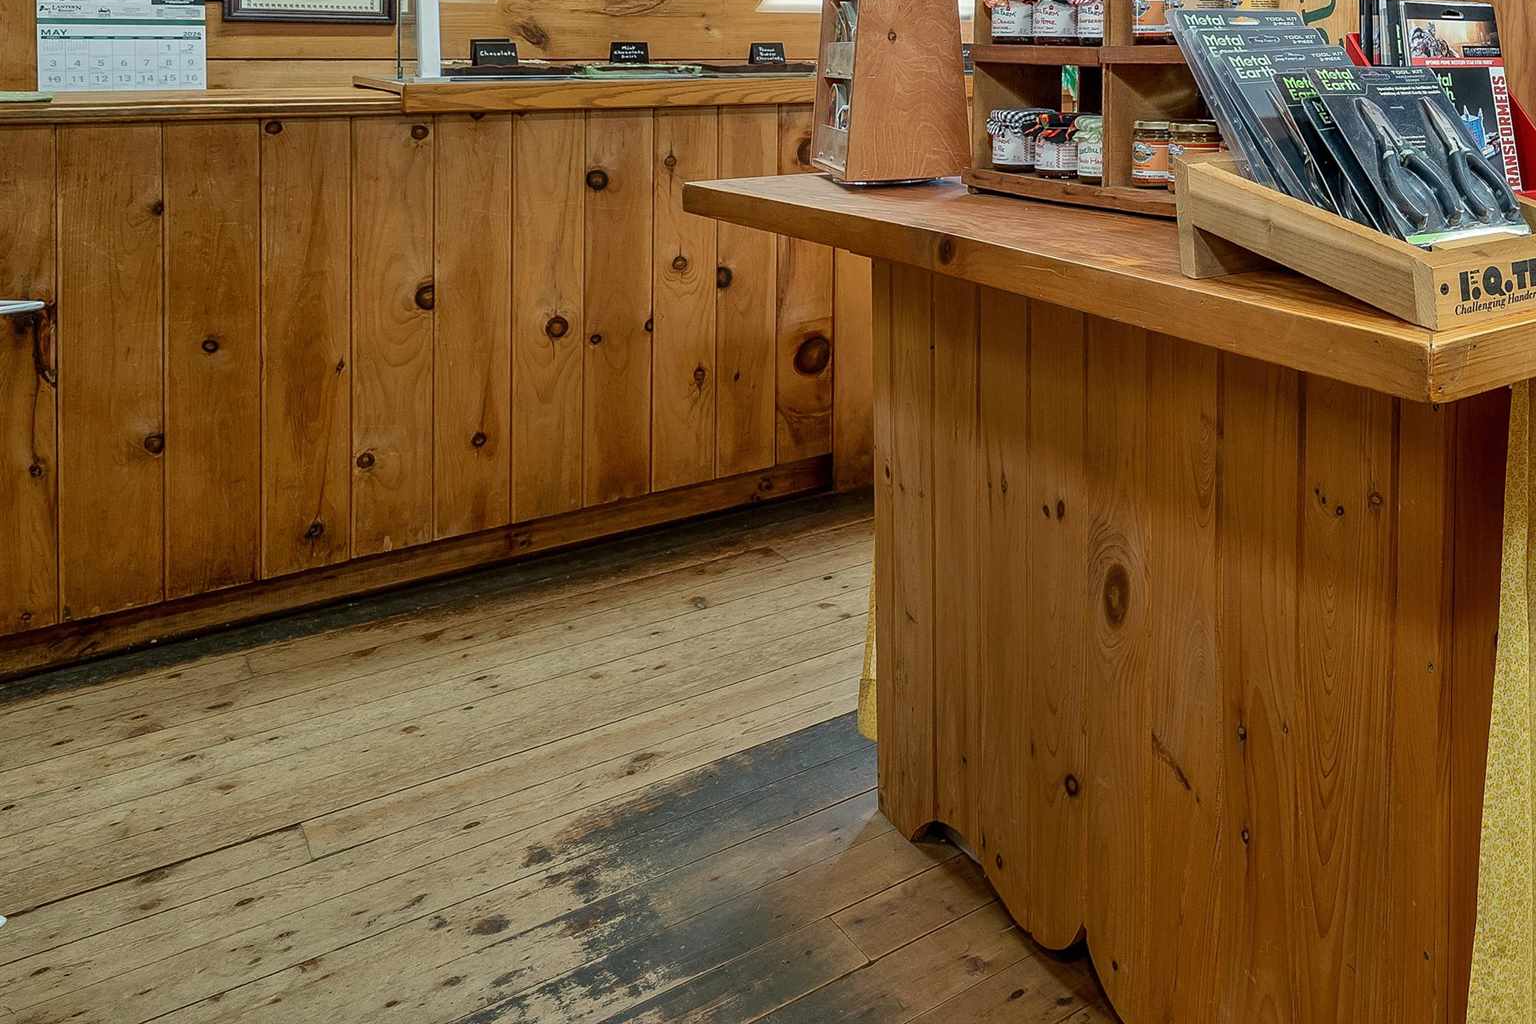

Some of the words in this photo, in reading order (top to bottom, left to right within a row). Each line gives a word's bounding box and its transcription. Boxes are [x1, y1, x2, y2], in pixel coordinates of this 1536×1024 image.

[1183, 14, 1226, 27] Metal
[1204, 34, 1245, 47] Metal
[50, 59, 57, 67] 3
[74, 59, 81, 67] 4
[98, 59, 105, 67] 5
[121, 59, 128, 67] 6
[1228, 55, 1272, 67] Metal
[95, 75, 108, 83] 12
[1238, 66, 1277, 79] Earth
[1317, 67, 1352, 80] Metal
[1323, 78, 1360, 91] Earth
[1492, 75, 1521, 189] RANSFORMERS
[1459, 265, 1514, 302] I.Q.
[1454, 298, 1505, 316] Challenging
